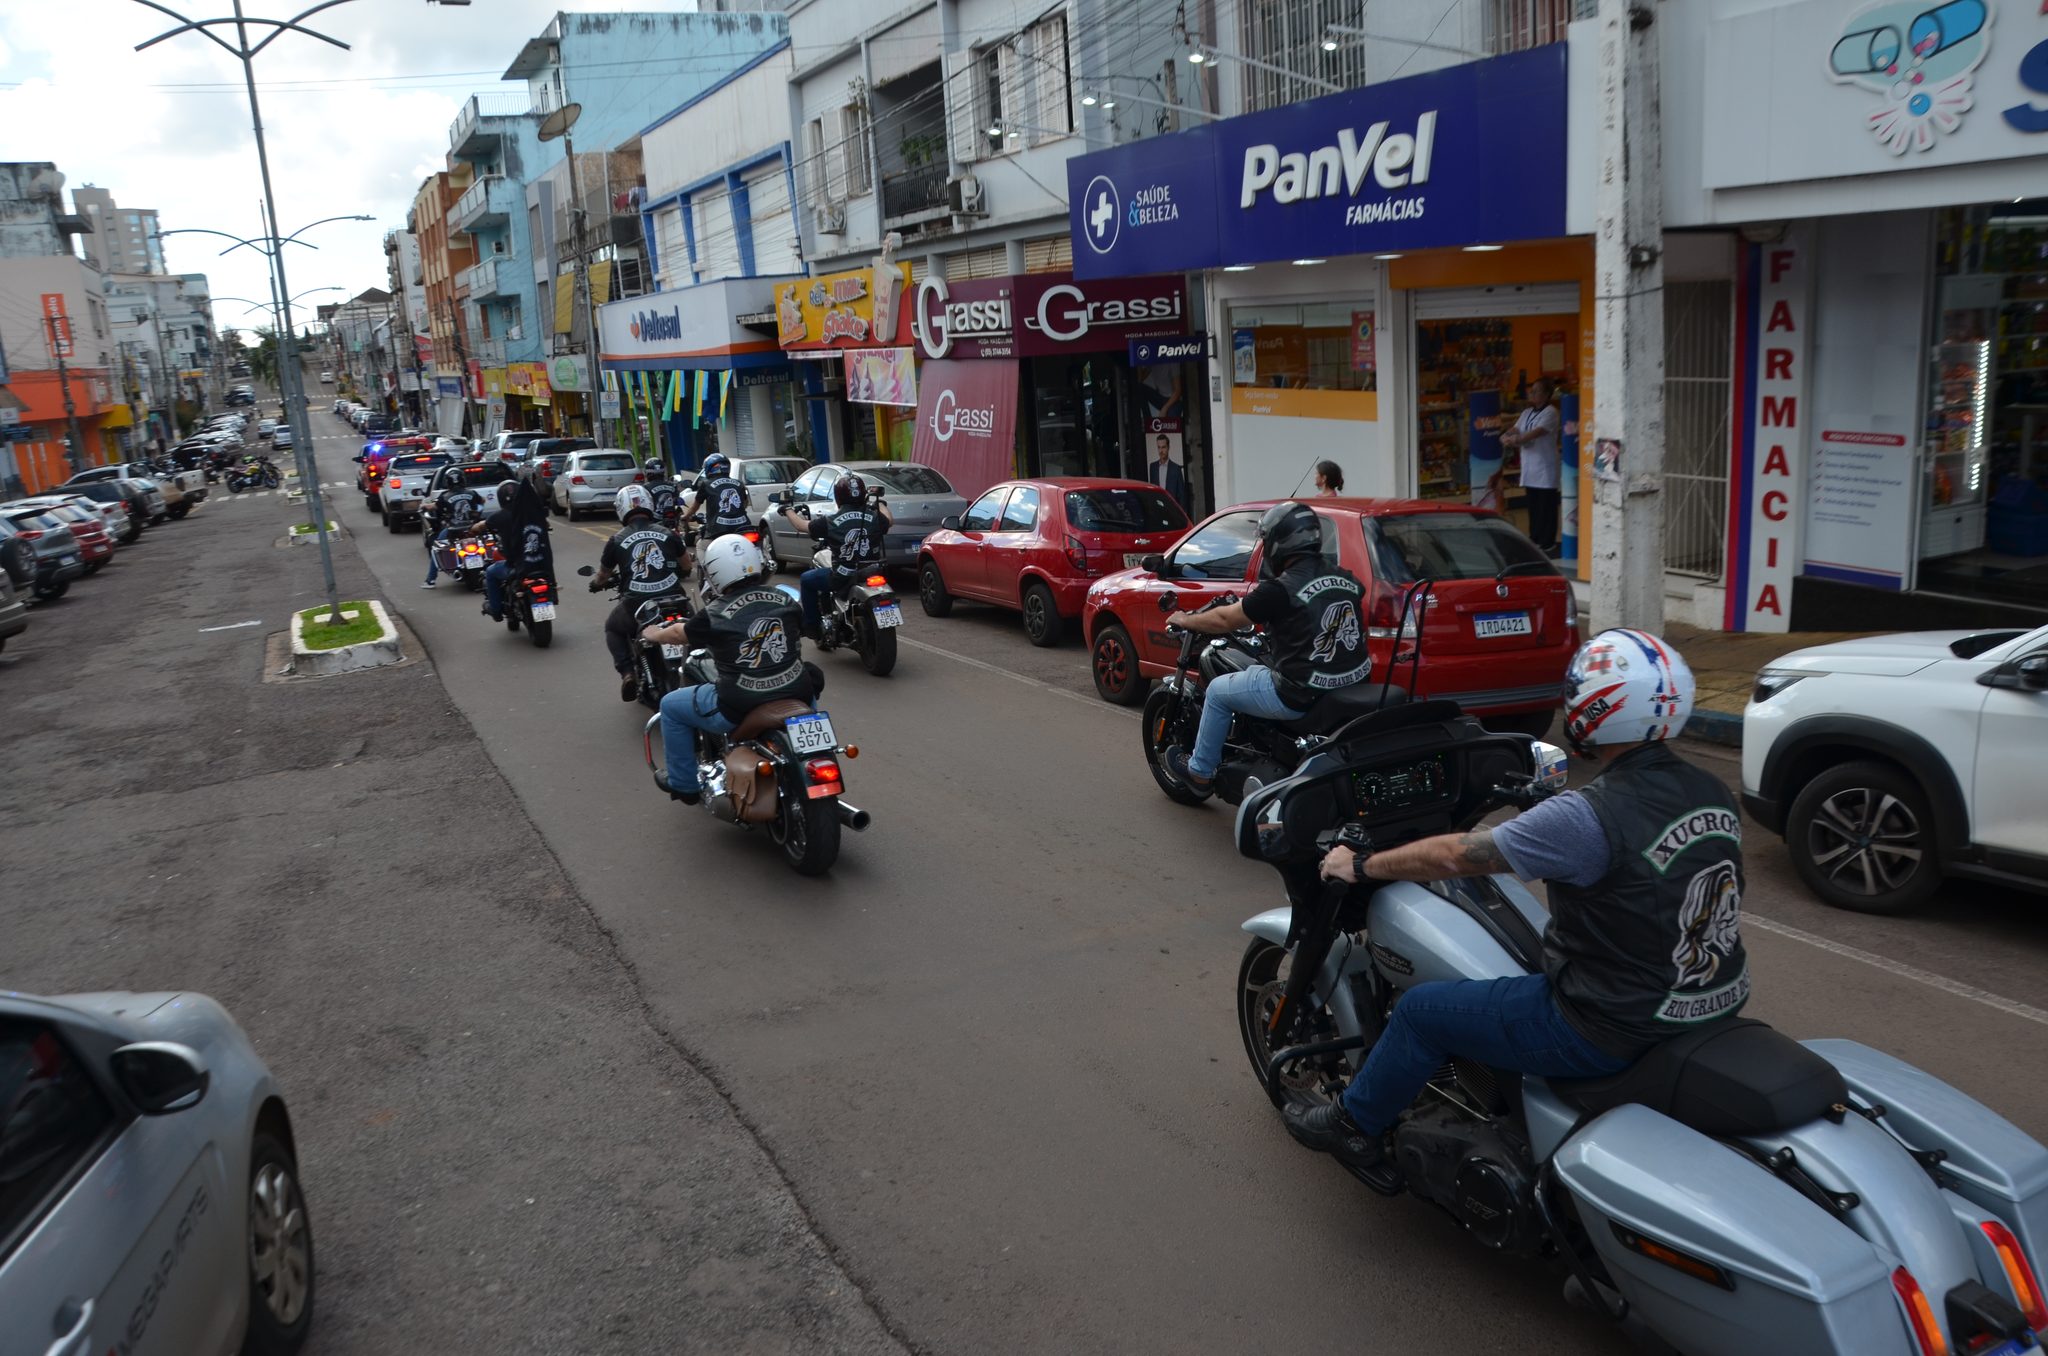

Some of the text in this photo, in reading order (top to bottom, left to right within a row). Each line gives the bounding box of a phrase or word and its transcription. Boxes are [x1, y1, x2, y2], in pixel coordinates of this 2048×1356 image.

[1240, 110, 1438, 209] PanVel
[1135, 184, 1171, 206] SAÚDE
[1139, 201, 1179, 226] BELEZA
[1345, 196, 1426, 227] FARMÁCIAS
[639, 304, 682, 342] Deltasul
[912, 275, 1012, 359] Grassi
[1025, 284, 1181, 341] Grassi
[1124, 329, 1180, 339] MODA MASCULINA
[1157, 342, 1202, 358] PanVel
[742, 372, 789, 386] Deltasul
[930, 388, 994, 442] Grassi
[1753, 249, 1797, 617] FARMACIA
[623, 532, 665, 545] XUCROS
[1302, 578, 1356, 597] XUCROS
[727, 591, 783, 616] XUCROS
[880, 610, 896, 619] MBR
[1481, 618, 1526, 635] IRD4A21
[740, 677, 755, 689] RIO
[755, 675, 786, 690] GRANDE
[784, 670, 795, 682] DO
[1313, 674, 1327, 688] RIO
[1327, 673, 1354, 688] GRANDE
[1354, 669, 1364, 681] DO
[1583, 697, 1612, 721] USA
[798, 720, 824, 735] AZQ
[796, 731, 832, 749] 5G70
[1655, 811, 1740, 863] XUCROS
[1662, 999, 1689, 1019] RIO
[1689, 986, 1738, 1018] GRANDE
